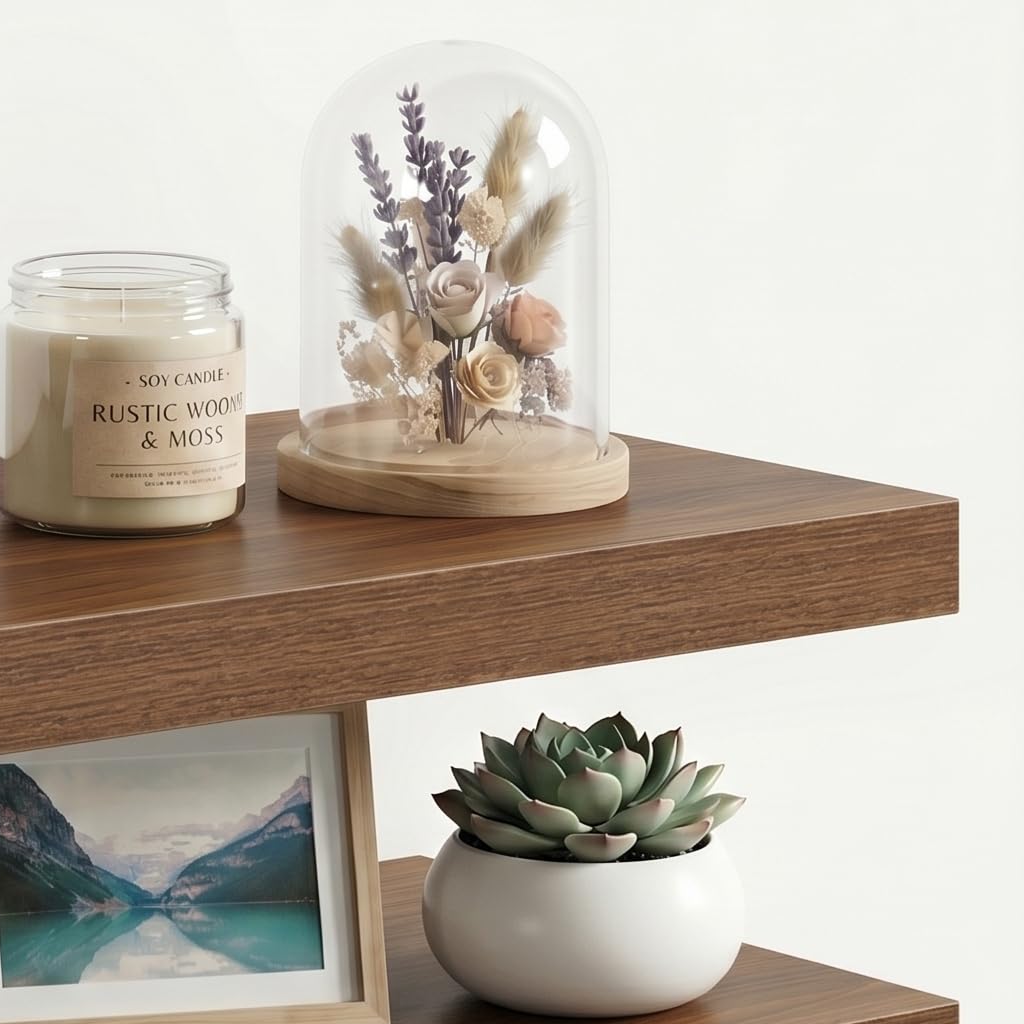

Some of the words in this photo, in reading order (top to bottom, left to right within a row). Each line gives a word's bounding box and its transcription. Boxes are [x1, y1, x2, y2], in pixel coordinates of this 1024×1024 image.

[139, 374, 170, 388] SOY
[174, 368, 225, 387] CANDLE
[92, 403, 178, 423] RUSTIC
[141, 430, 158, 450] &
[169, 425, 224, 449] MOSS
